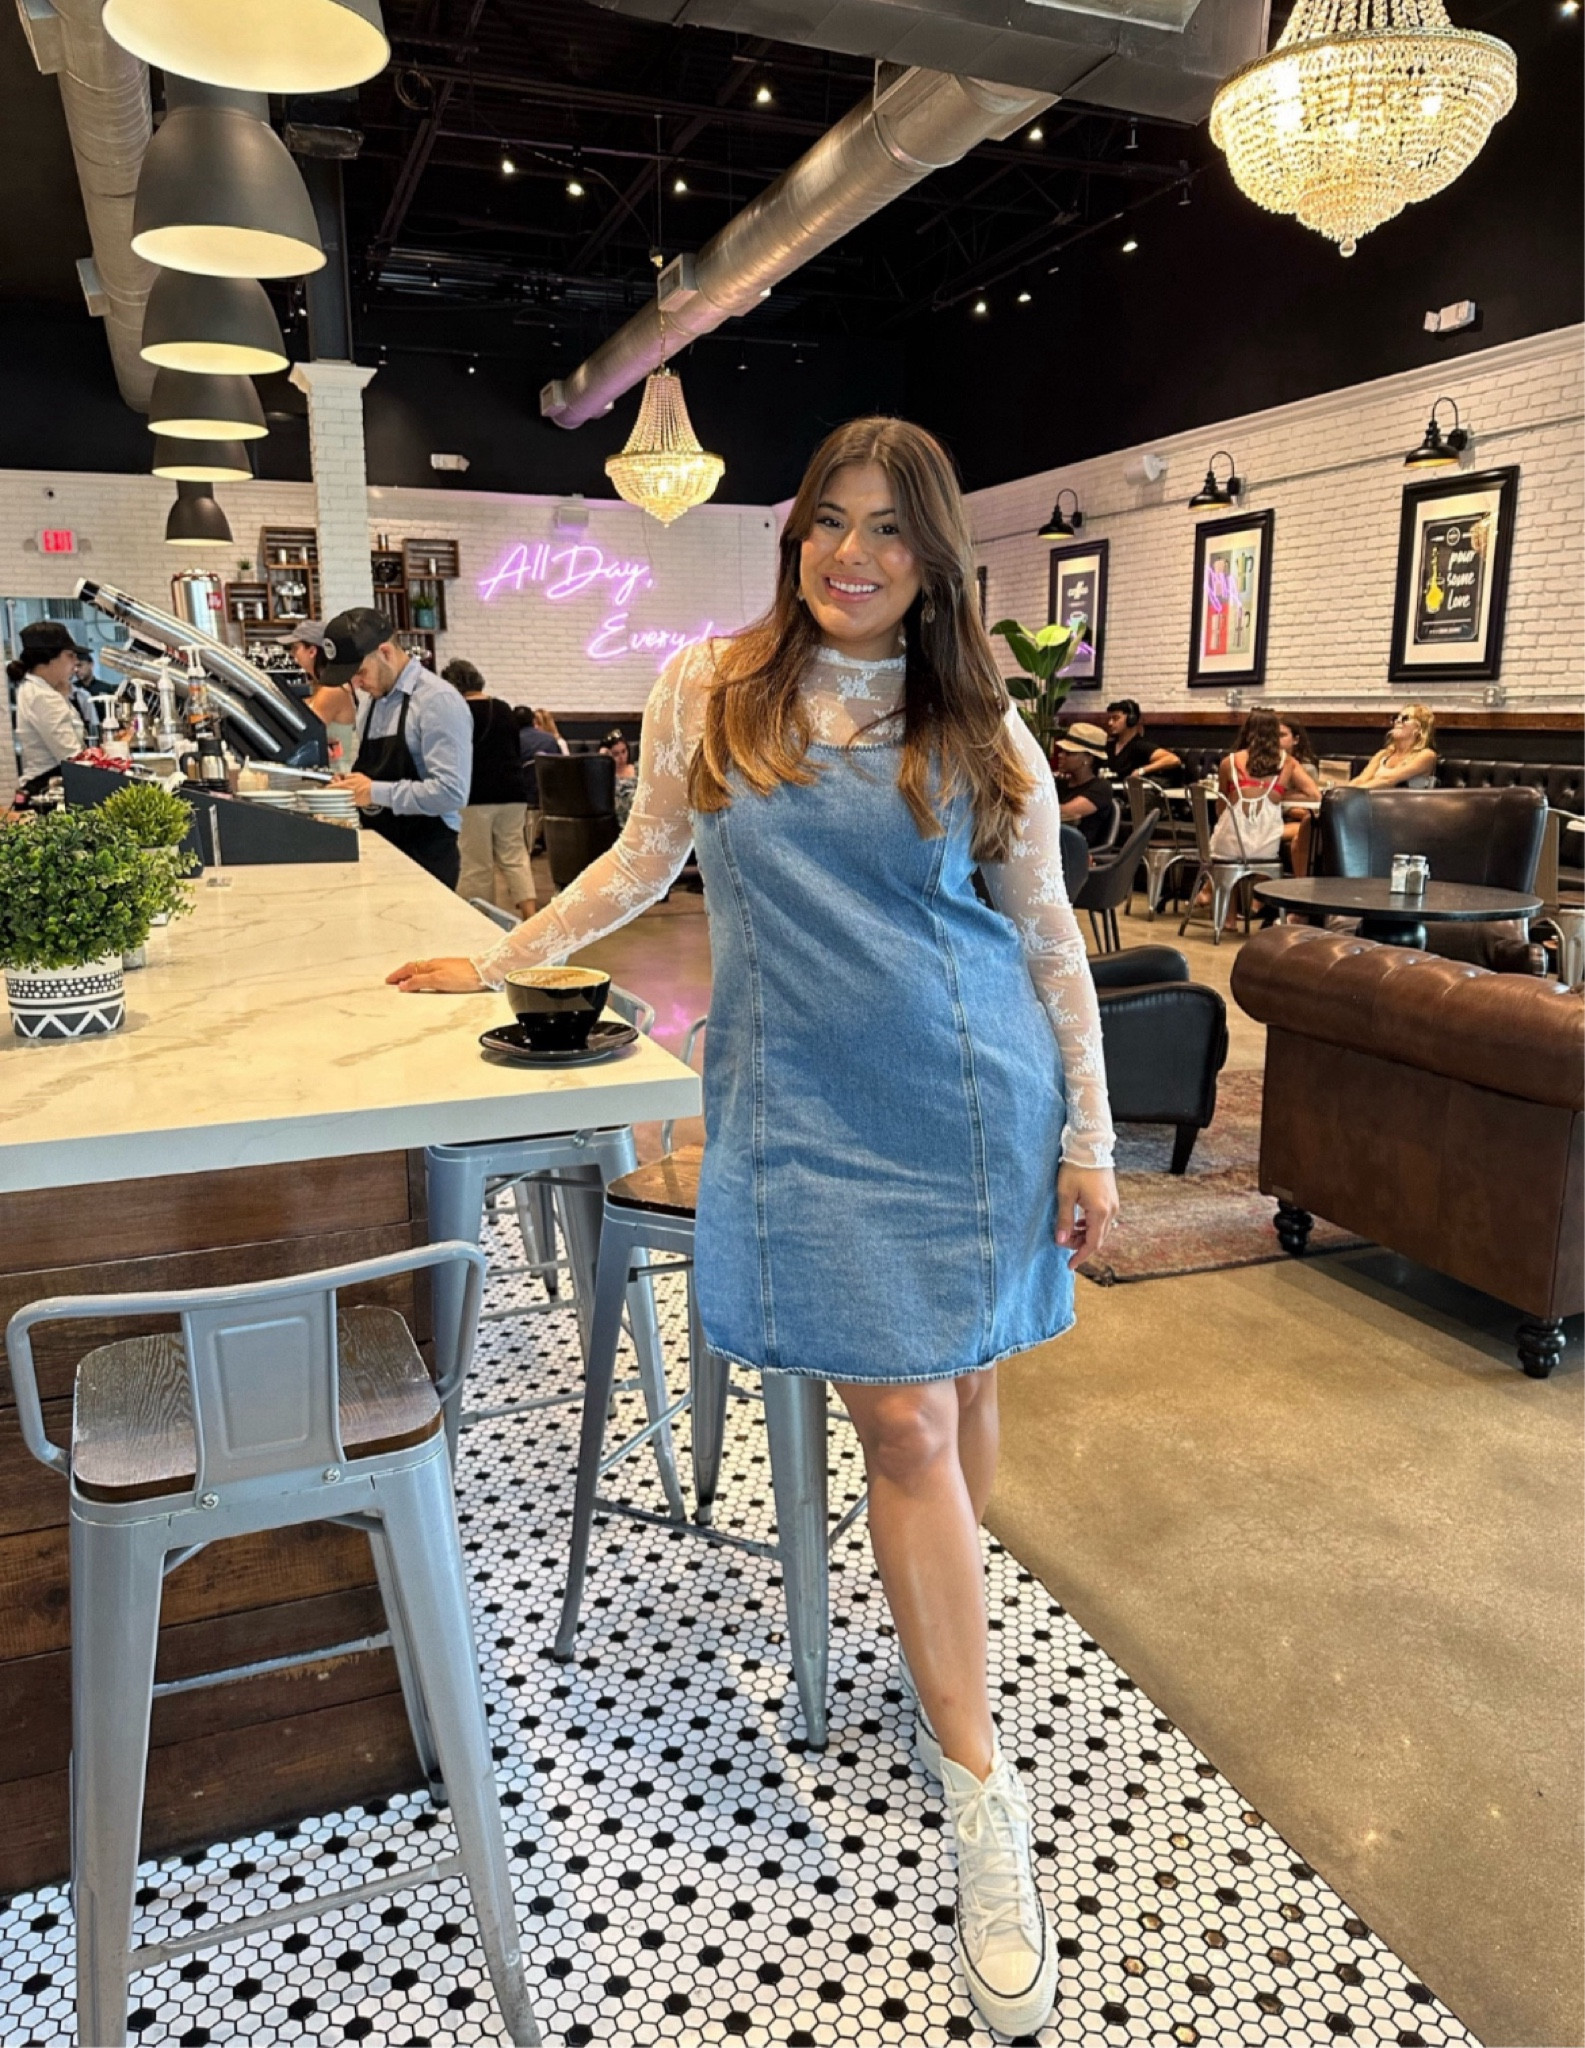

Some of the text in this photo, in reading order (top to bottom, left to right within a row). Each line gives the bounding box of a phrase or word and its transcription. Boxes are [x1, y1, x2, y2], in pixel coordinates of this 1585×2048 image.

[479, 543, 654, 605] All Day,
[1448, 550, 1476, 571] pour
